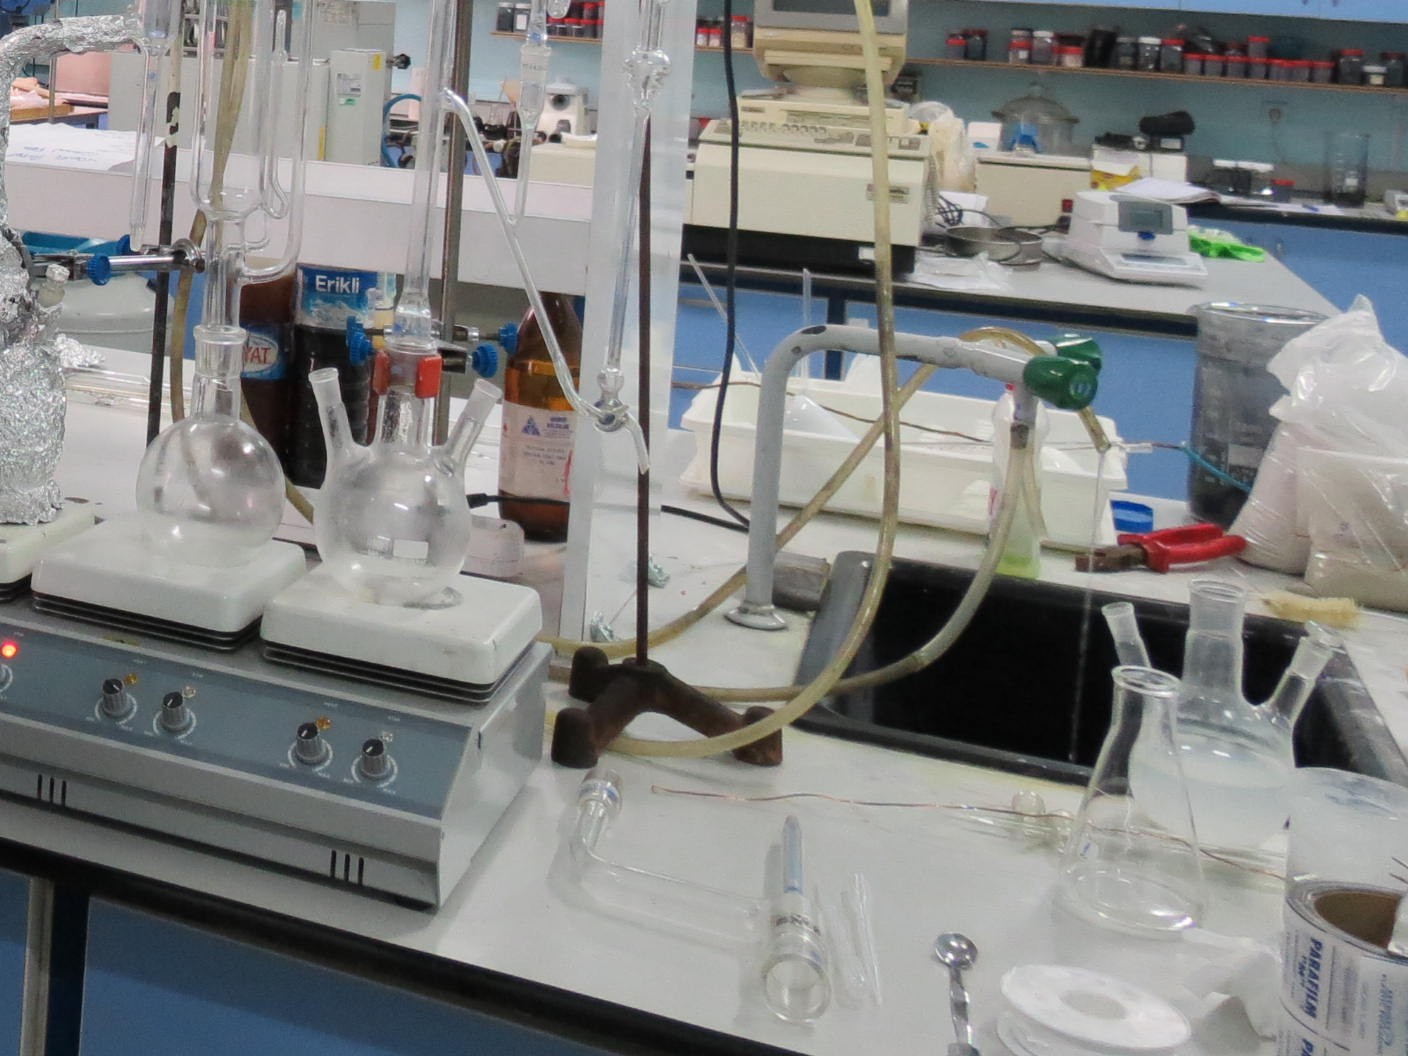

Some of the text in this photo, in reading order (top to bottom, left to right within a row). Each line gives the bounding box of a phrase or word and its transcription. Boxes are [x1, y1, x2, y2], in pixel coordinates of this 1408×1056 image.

[315, 274, 360, 294] Erikli
[244, 346, 271, 364] YAT
[1303, 936, 1324, 1019] PARAFILM
